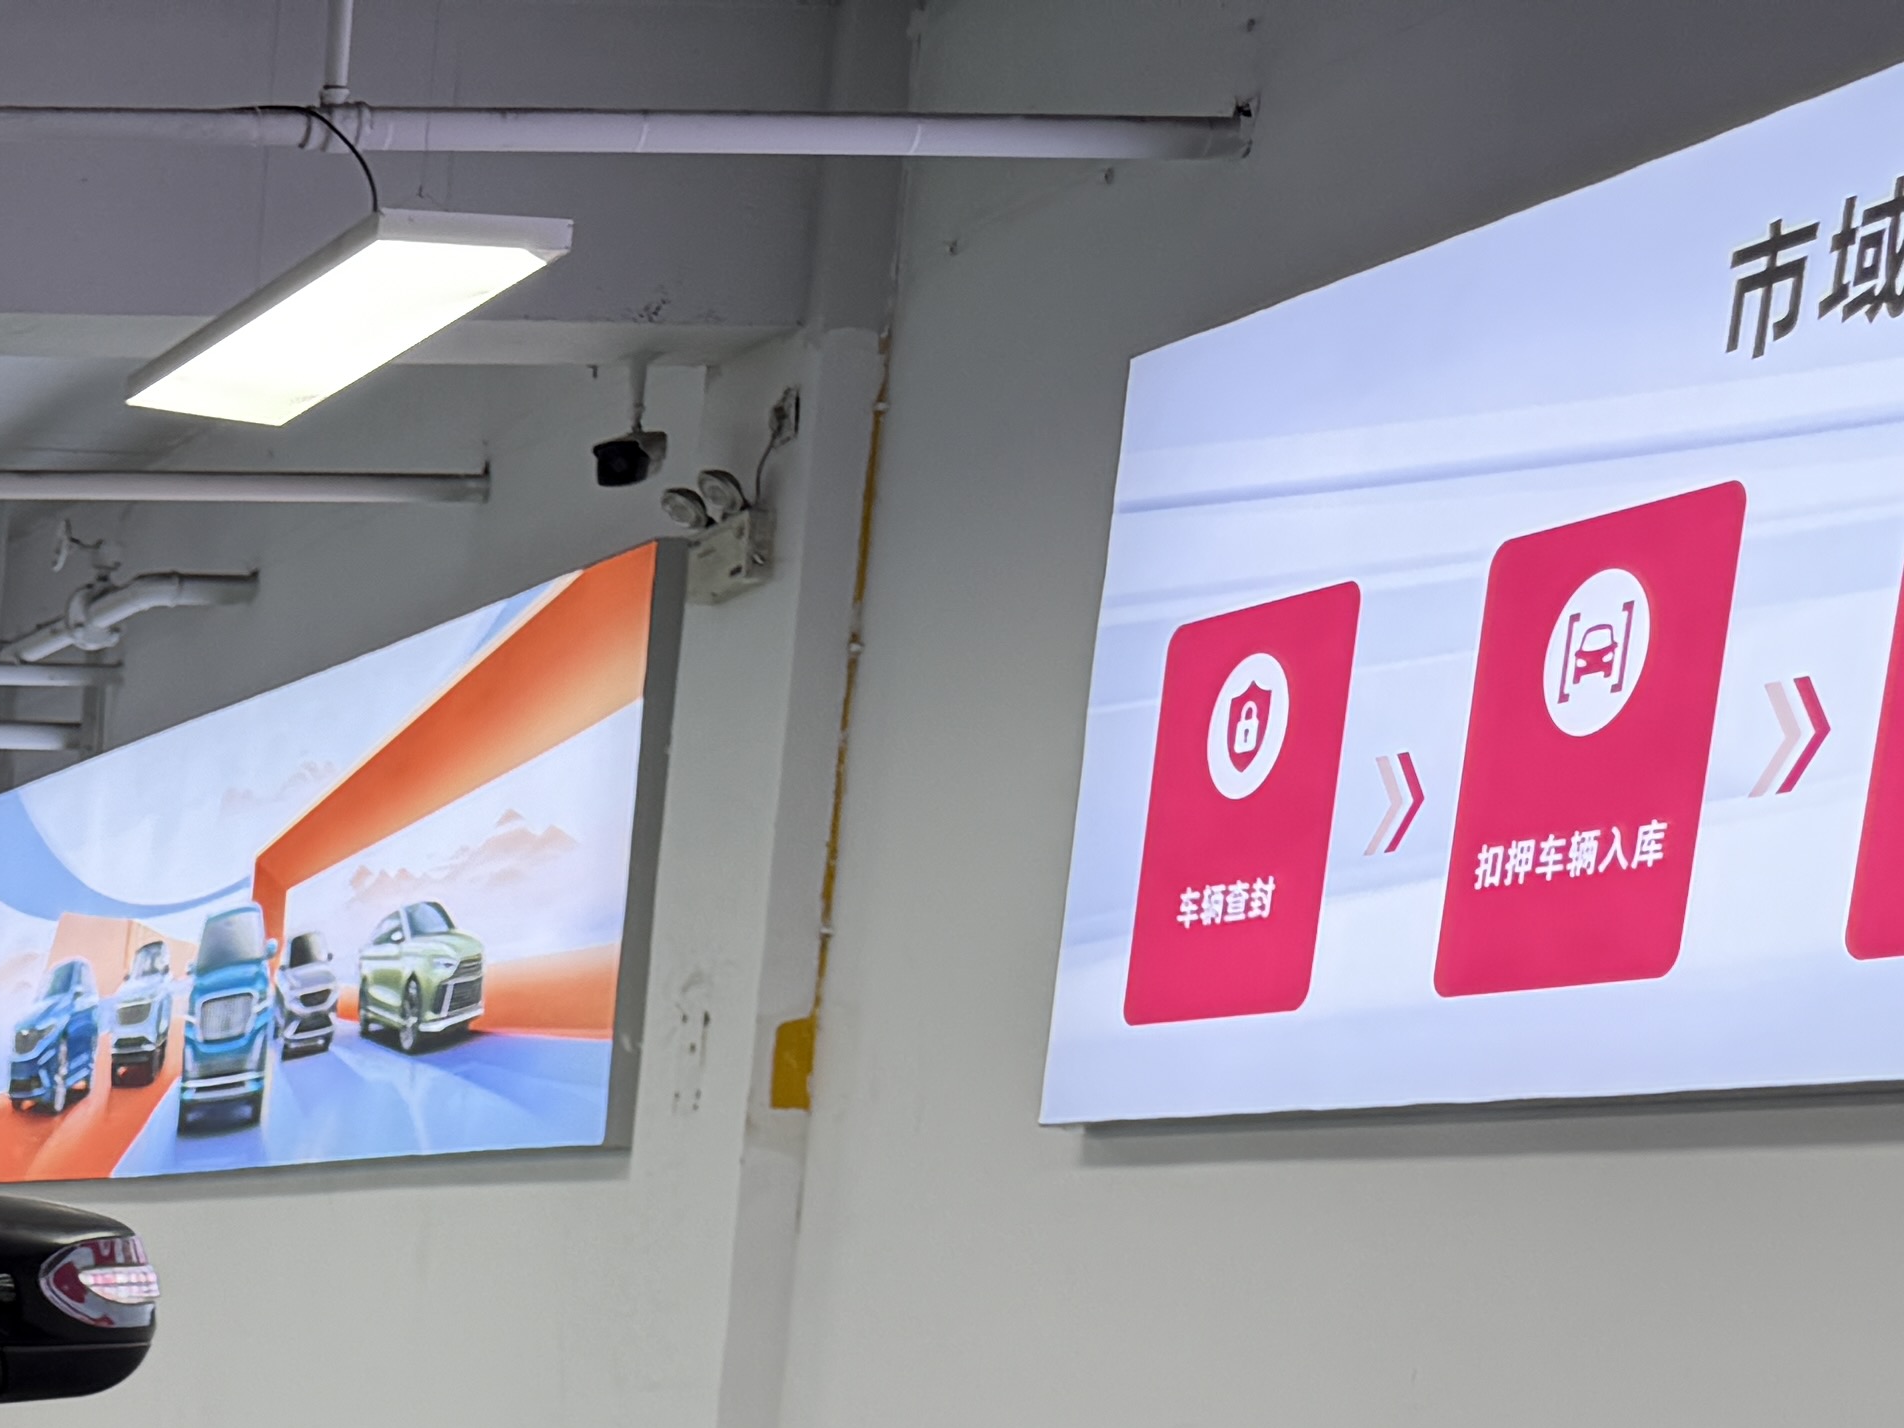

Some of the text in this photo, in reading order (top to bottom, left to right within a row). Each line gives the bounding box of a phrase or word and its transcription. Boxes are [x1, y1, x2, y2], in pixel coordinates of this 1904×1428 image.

[1725, 174, 1904, 360] 市域
[1473, 819, 1668, 890] 扣押车辆入库
[1175, 876, 1276, 929] 车辆查封
